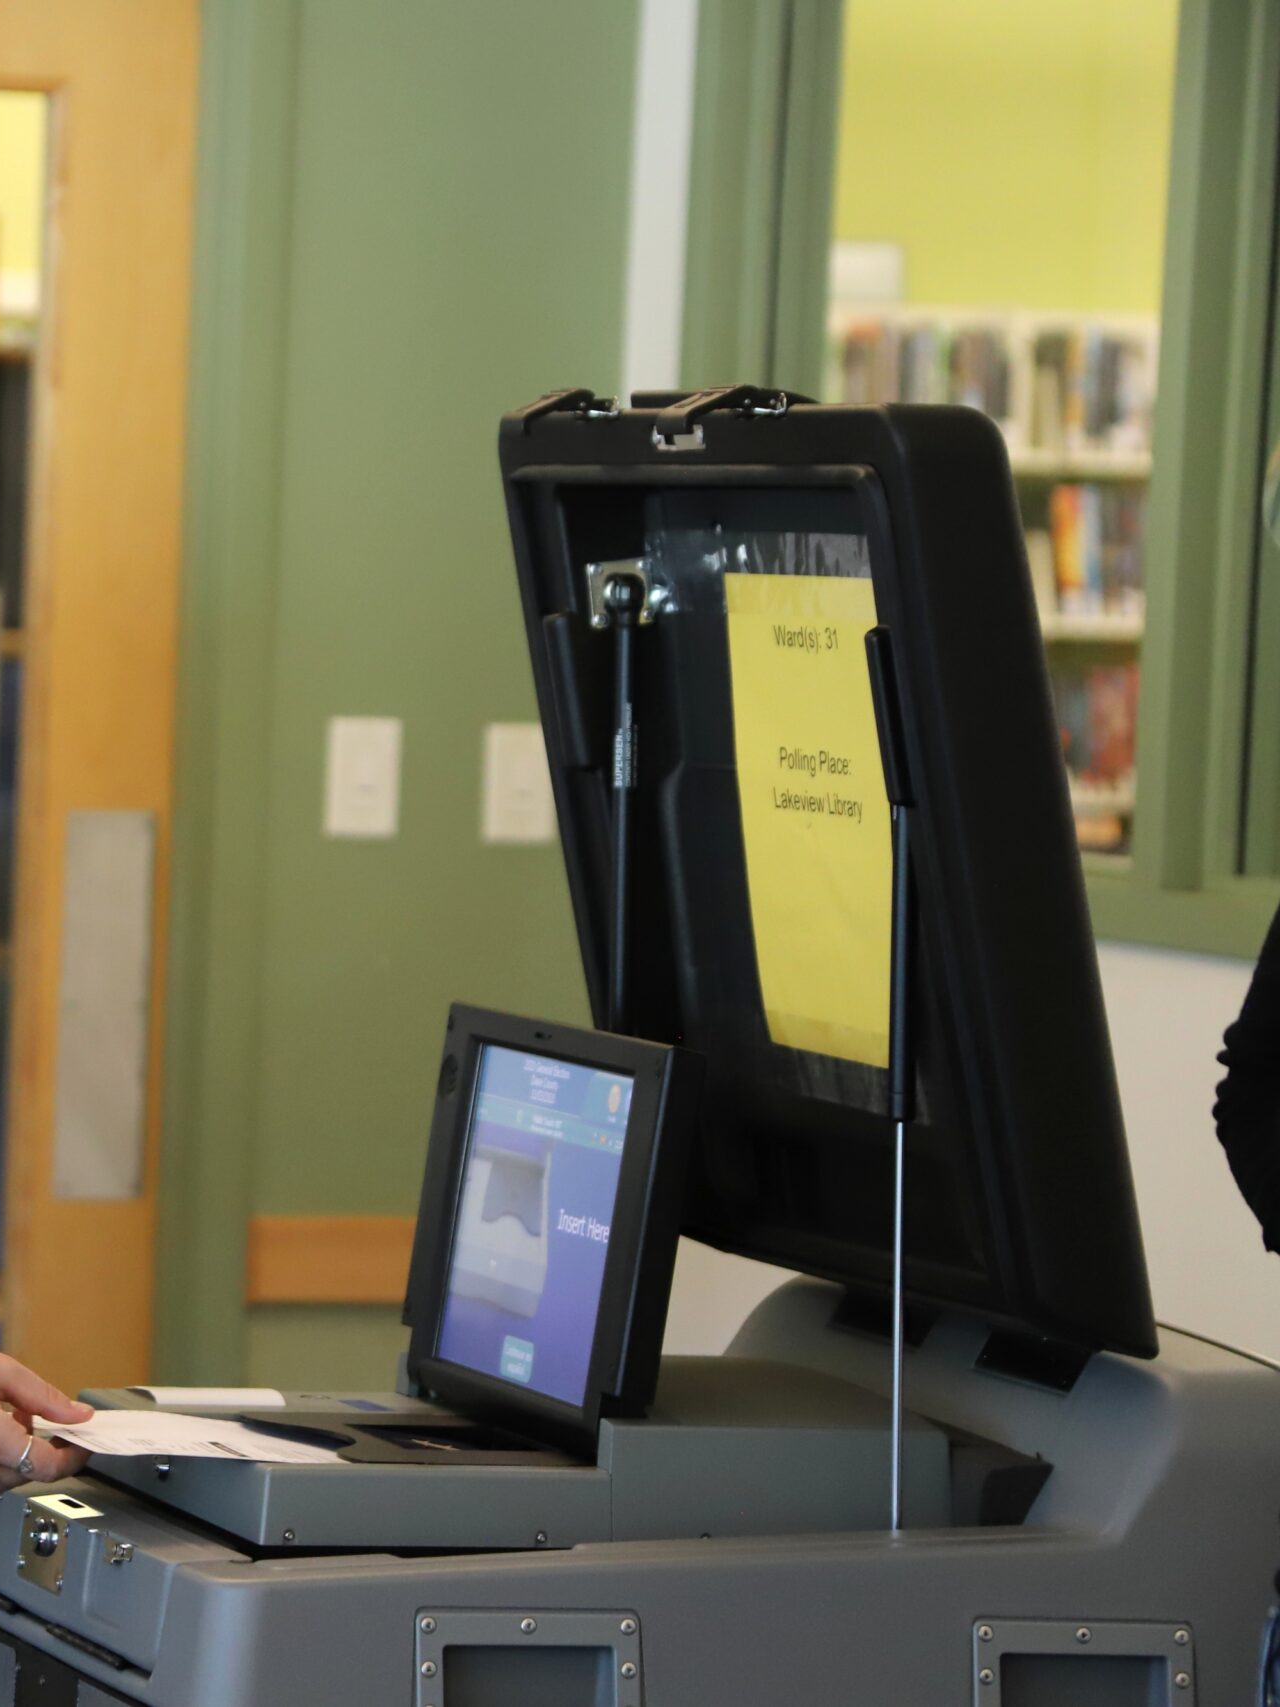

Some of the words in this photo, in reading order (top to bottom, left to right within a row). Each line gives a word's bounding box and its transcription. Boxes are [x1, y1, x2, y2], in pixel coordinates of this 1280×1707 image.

[773, 624, 822, 653] Ward(s):
[825, 627, 839, 649] 31
[779, 747, 817, 778] Polling
[819, 750, 852, 776] Place:
[773, 786, 824, 813] Lakeview
[827, 793, 862, 825] Library
[557, 1207, 585, 1238] Insert
[587, 1214, 609, 1244] Here
